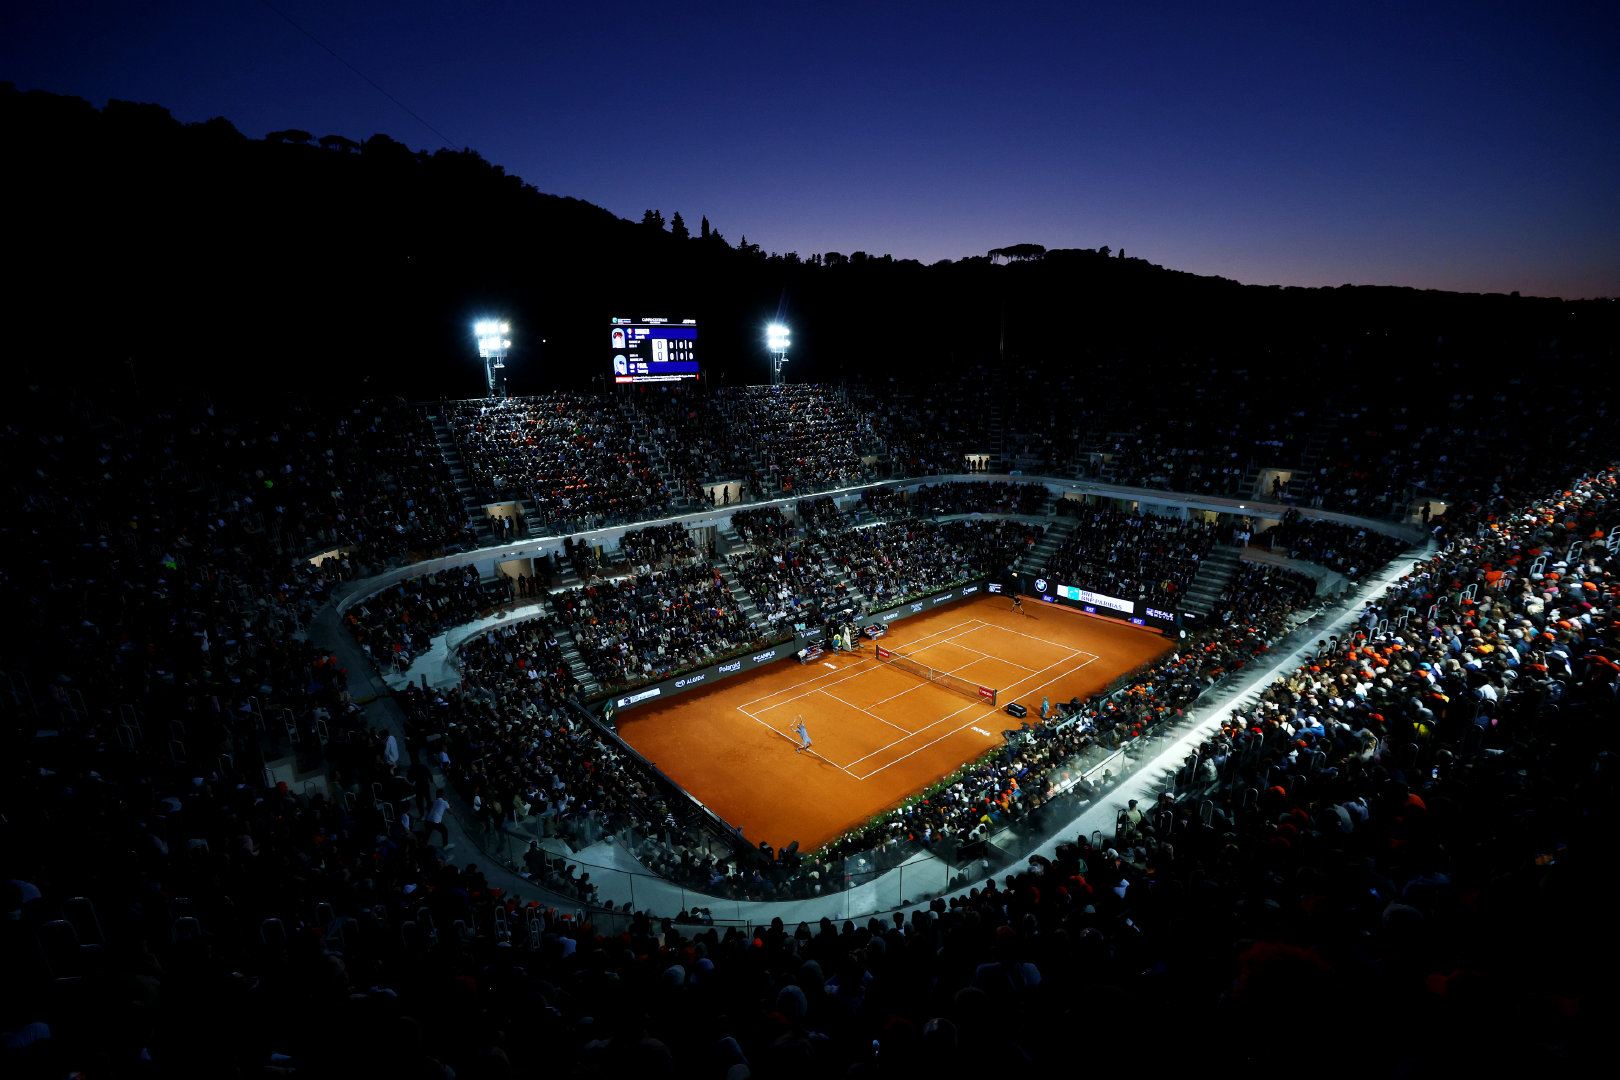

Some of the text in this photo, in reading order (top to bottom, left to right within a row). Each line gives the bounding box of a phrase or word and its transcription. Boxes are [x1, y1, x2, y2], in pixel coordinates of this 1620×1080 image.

[1094, 598, 1122, 610] PARIBAS
[1153, 609, 1174, 618] REALE
[718, 661, 741, 673] Polaroid
[687, 674, 705, 685] ALGIDA
